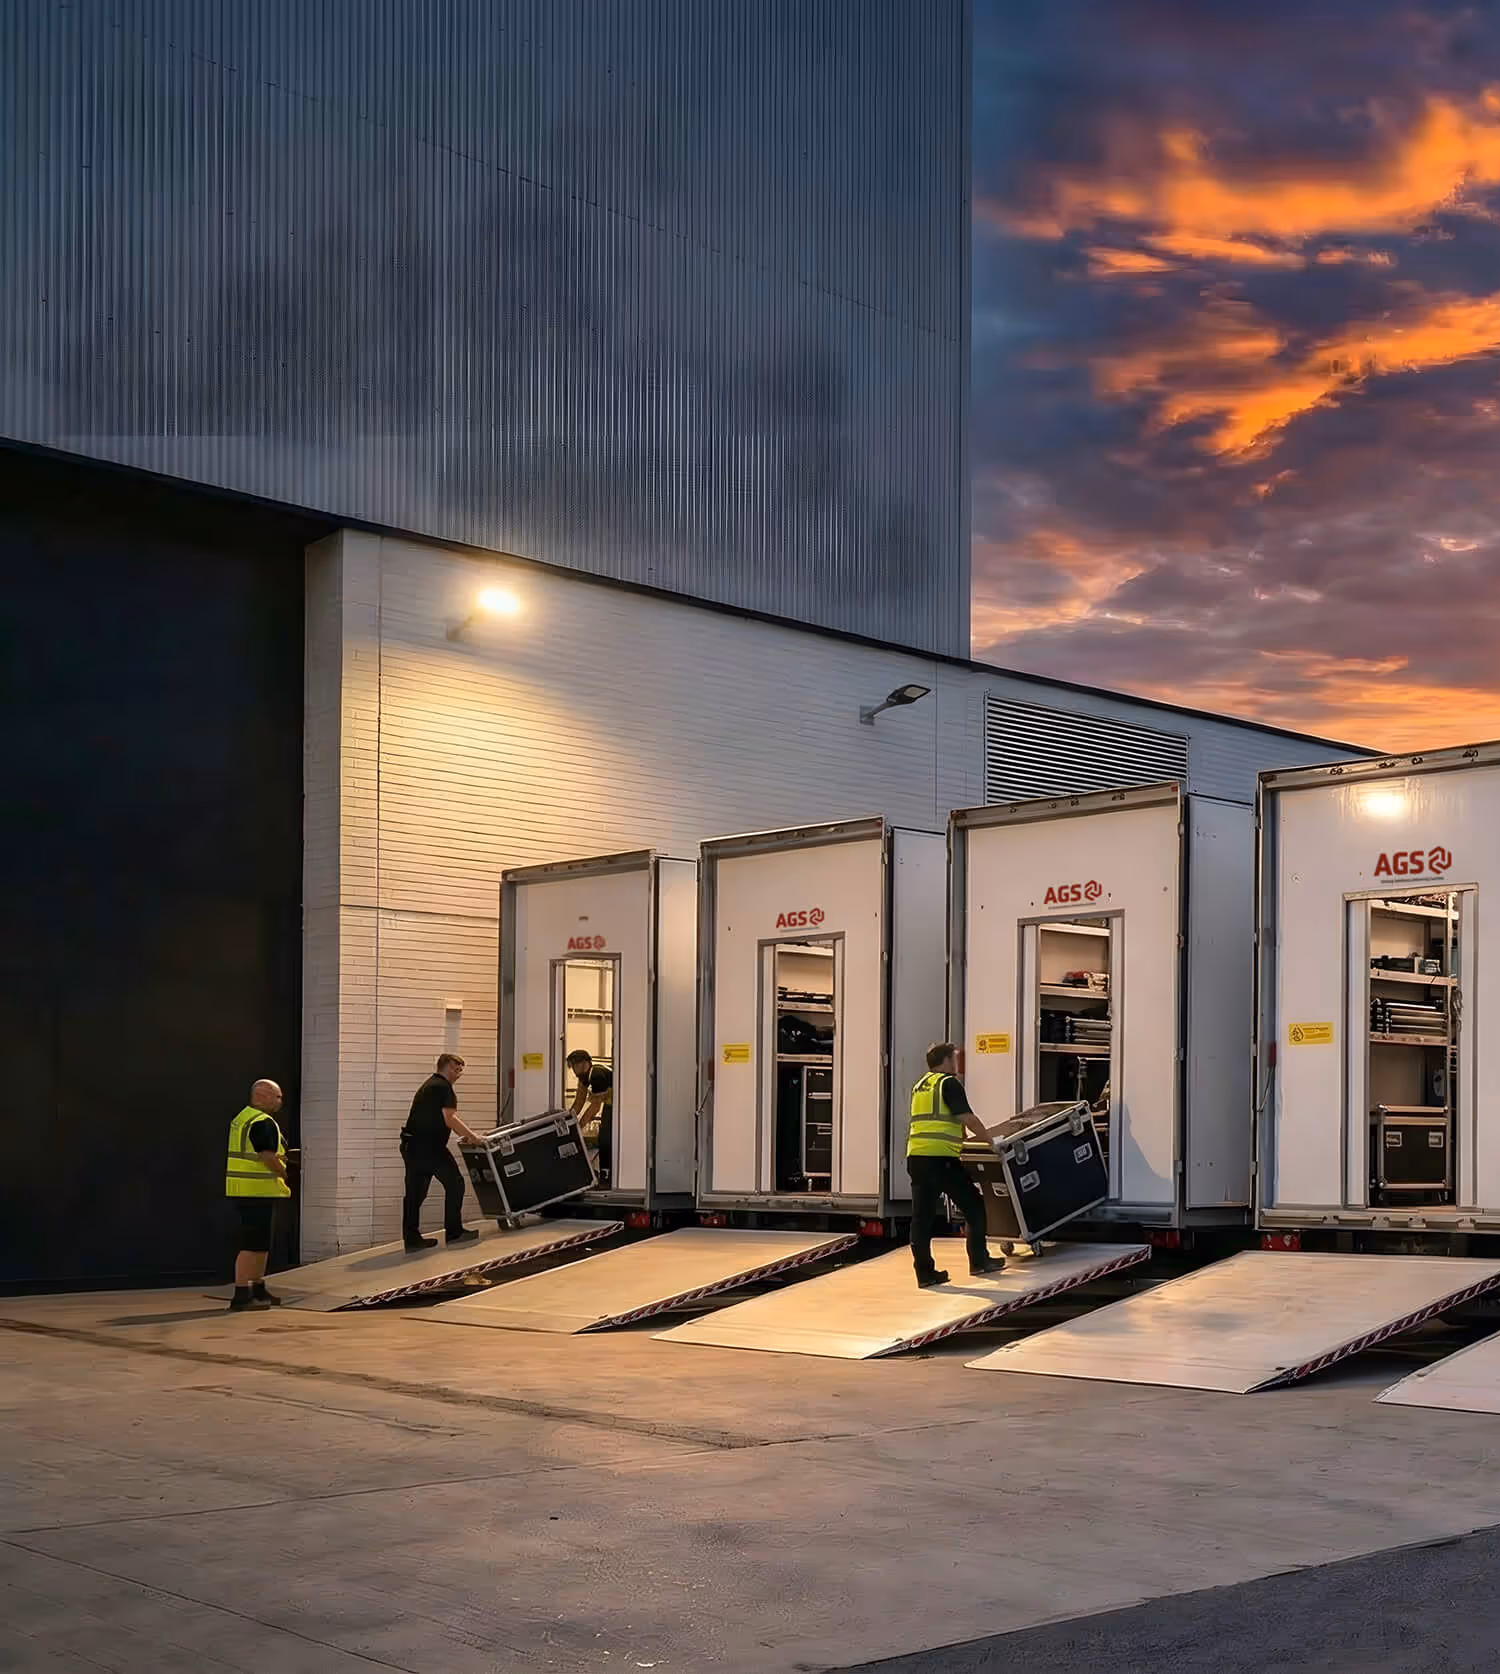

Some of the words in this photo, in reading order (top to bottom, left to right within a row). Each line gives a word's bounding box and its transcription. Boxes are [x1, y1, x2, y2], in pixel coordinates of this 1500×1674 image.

[1373, 850, 1425, 877] AGS
[1043, 883, 1082, 905] AGS
[775, 910, 808, 929] AGS
[567, 935, 593, 951] AGS
